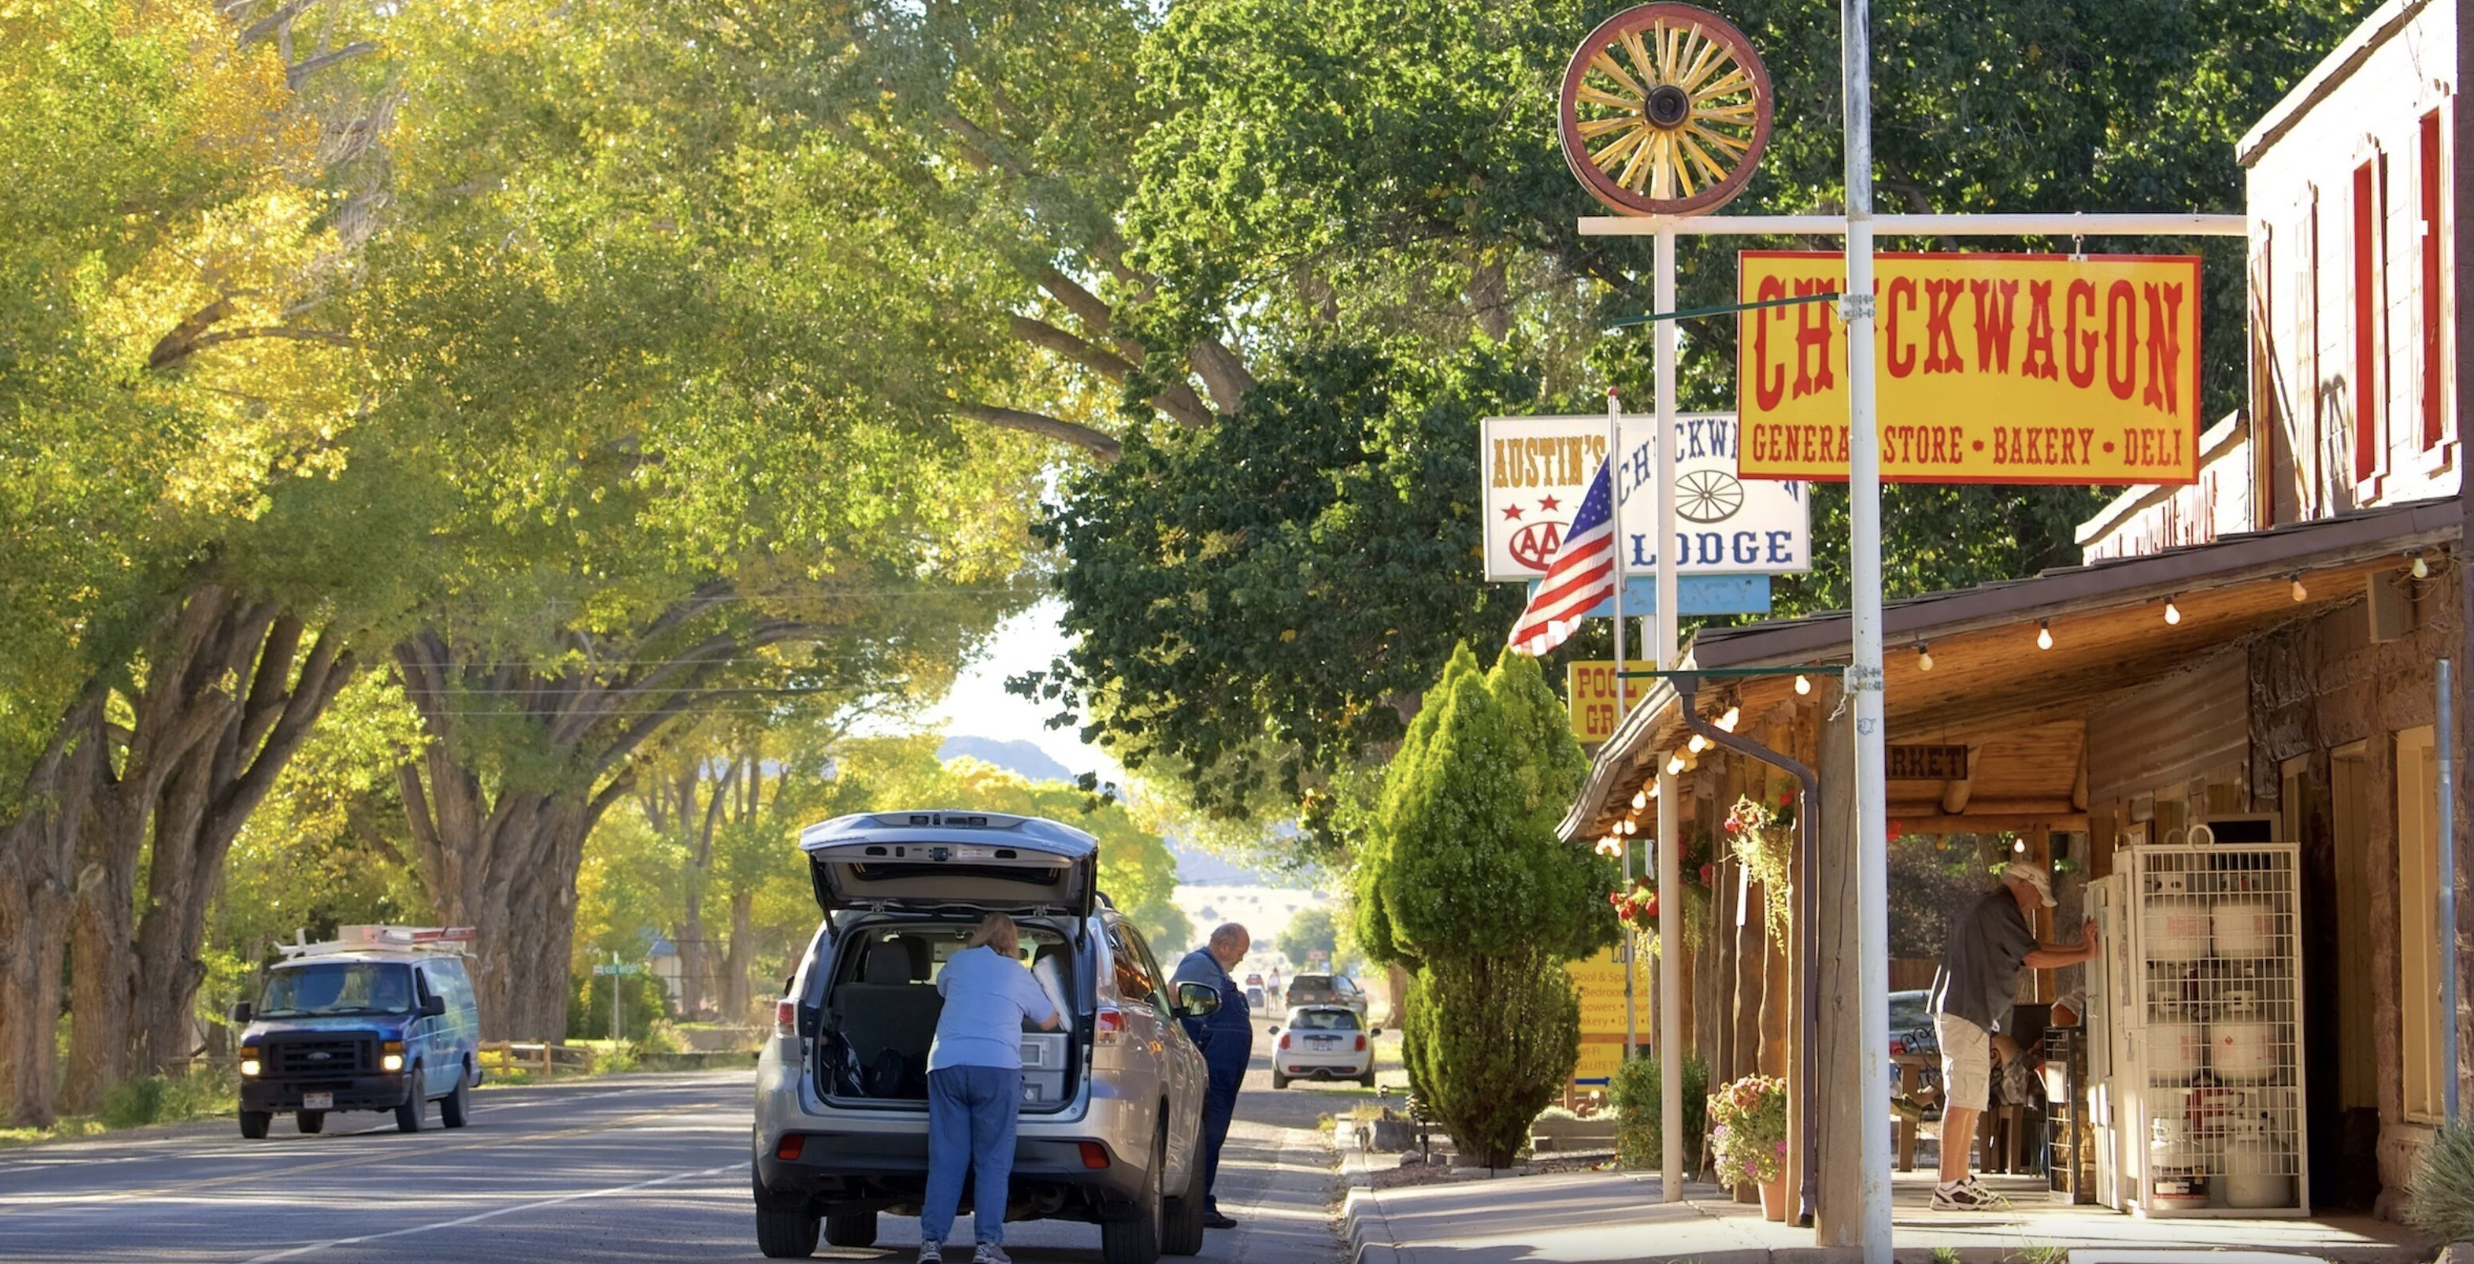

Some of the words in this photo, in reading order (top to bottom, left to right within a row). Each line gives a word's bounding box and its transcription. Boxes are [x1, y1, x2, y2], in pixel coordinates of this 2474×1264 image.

[1493, 434, 1606, 489] AUSTIN'S
[1753, 423, 1850, 463] GENERA
[1883, 425, 1963, 464] STORE
[1993, 426, 2094, 466] BAKERY
[2124, 428, 2182, 467] DELI
[1886, 746, 1963, 778] RKET
[1581, 1015, 1608, 1028] akery
